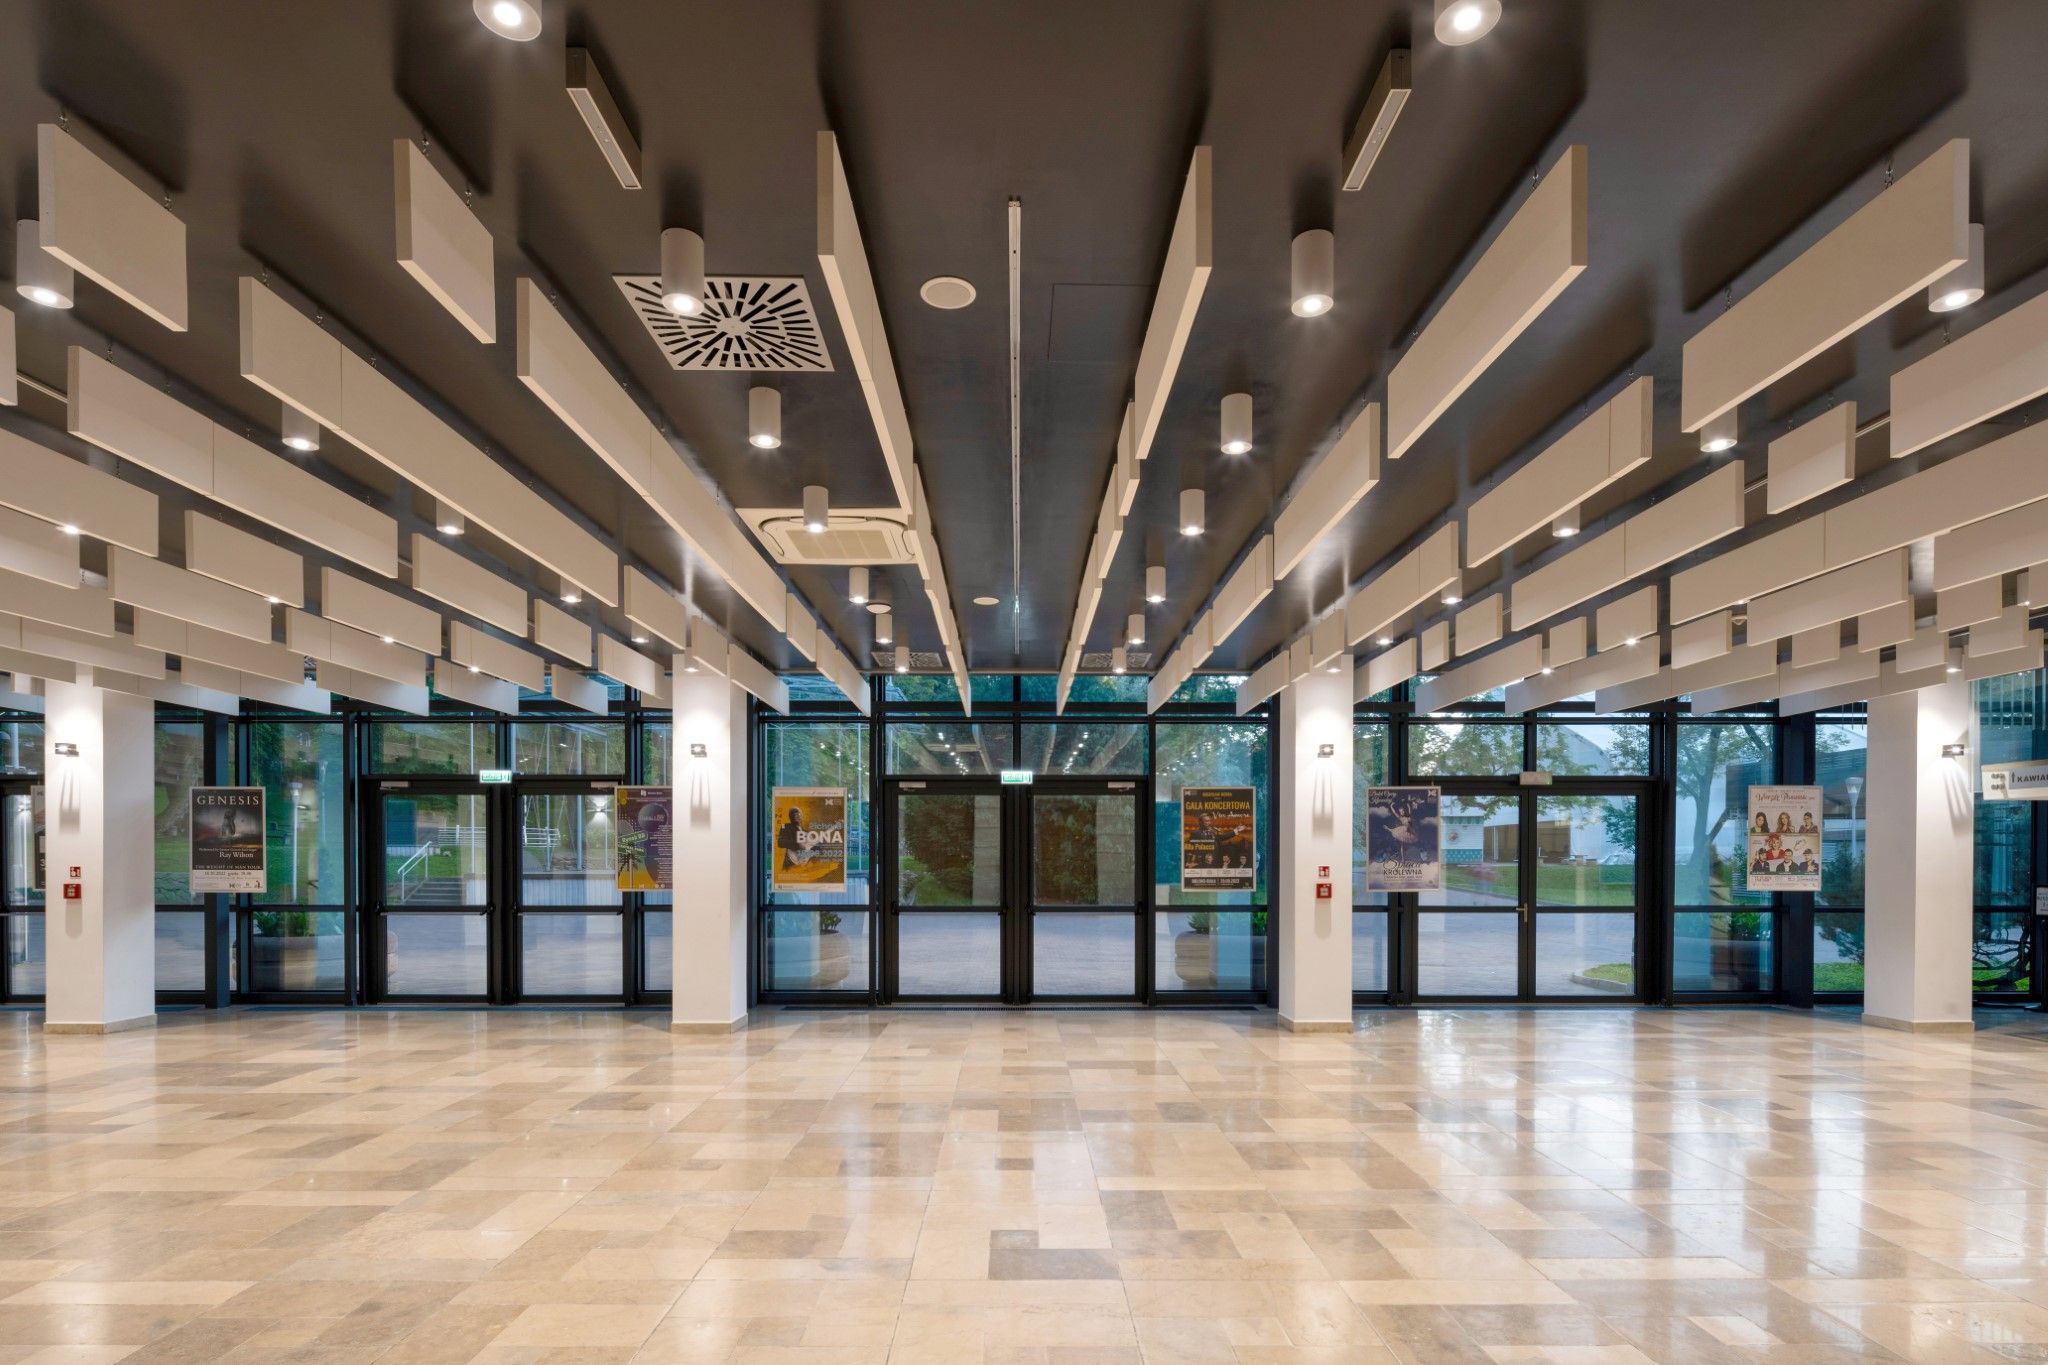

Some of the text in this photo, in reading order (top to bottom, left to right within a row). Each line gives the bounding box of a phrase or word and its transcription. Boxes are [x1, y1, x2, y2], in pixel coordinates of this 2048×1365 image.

[2017, 773, 2048, 783] KAWIA
[196, 795, 259, 805] GENESIS
[1185, 801, 1250, 810] GALA KONCERTOWA
[796, 830, 843, 843] BONA
[219, 851, 232, 859] Ray
[1383, 868, 1423, 876] KRÓLEWNA
